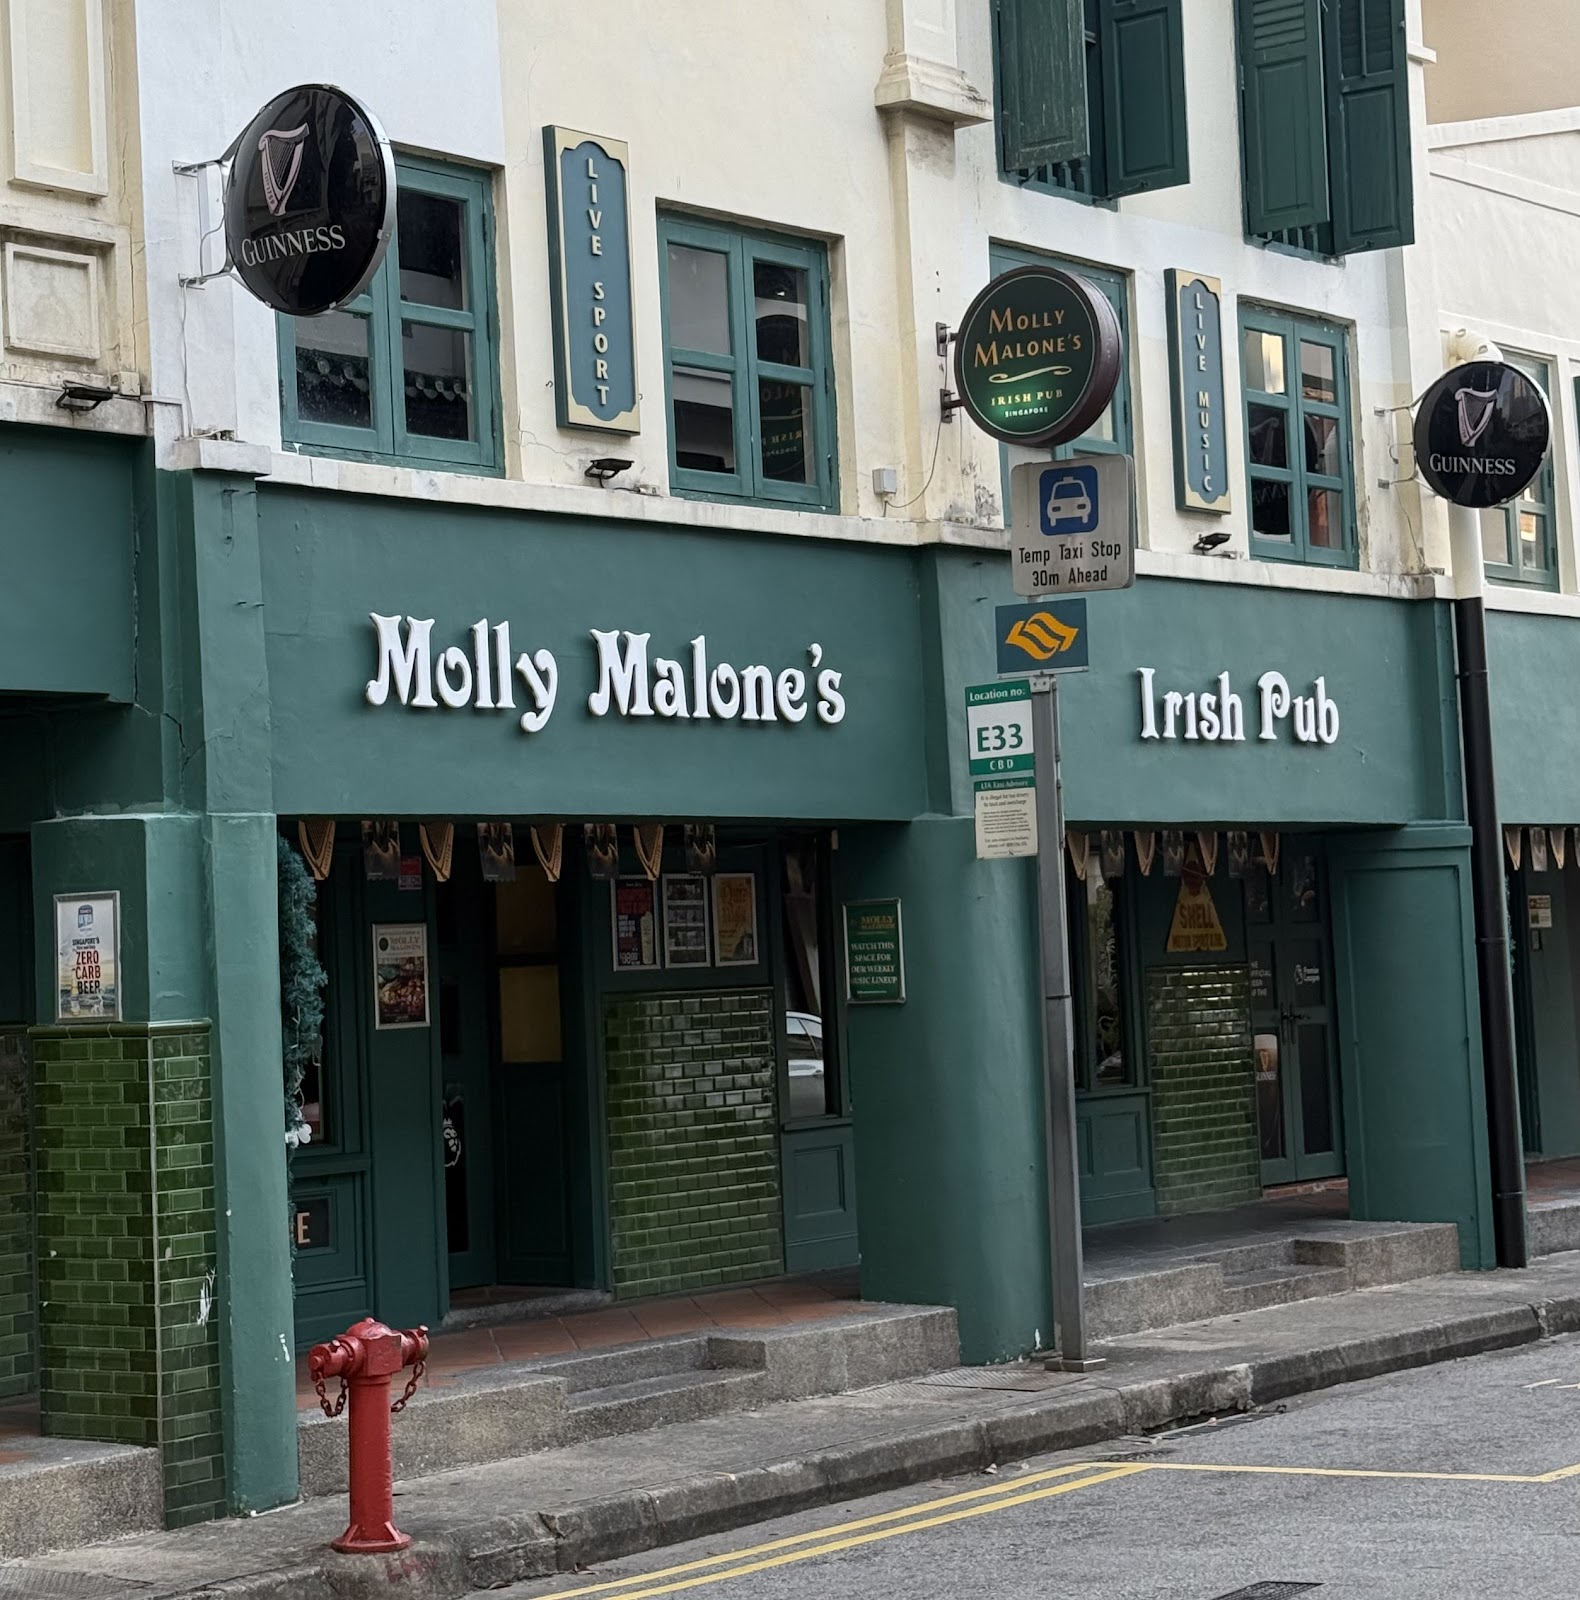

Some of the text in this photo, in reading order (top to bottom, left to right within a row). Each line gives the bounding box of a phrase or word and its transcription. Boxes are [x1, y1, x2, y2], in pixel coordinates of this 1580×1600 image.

[241, 225, 346, 267] GUINNESS
[586, 157, 609, 406] LIVE SPORT
[988, 307, 1065, 334] MOLLY
[974, 334, 1082, 368] MALONE'S
[991, 389, 1063, 406] IRISH PUB
[1194, 292, 1213, 492] LIVE MUSIC
[1004, 407, 1048, 418] SINGAPORE
[1429, 453, 1516, 475] GUINNESS
[1019, 540, 1121, 566] Temp Taxi Stop
[1032, 565, 1108, 587] 30m Ahead
[365, 612, 847, 733] Molly Malone's
[969, 688, 1008, 702] Location
[1136, 667, 1340, 744] Irish Pub
[976, 723, 1023, 752] E33
[851, 941, 895, 951] WATCH THIS
[76, 950, 99, 965] ZERO
[854, 953, 892, 962] SPACE FOR
[75, 965, 101, 980] CARB
[851, 965, 867, 973] OUR
[871, 976, 898, 984] LINEUP
[77, 980, 100, 995] BEER
